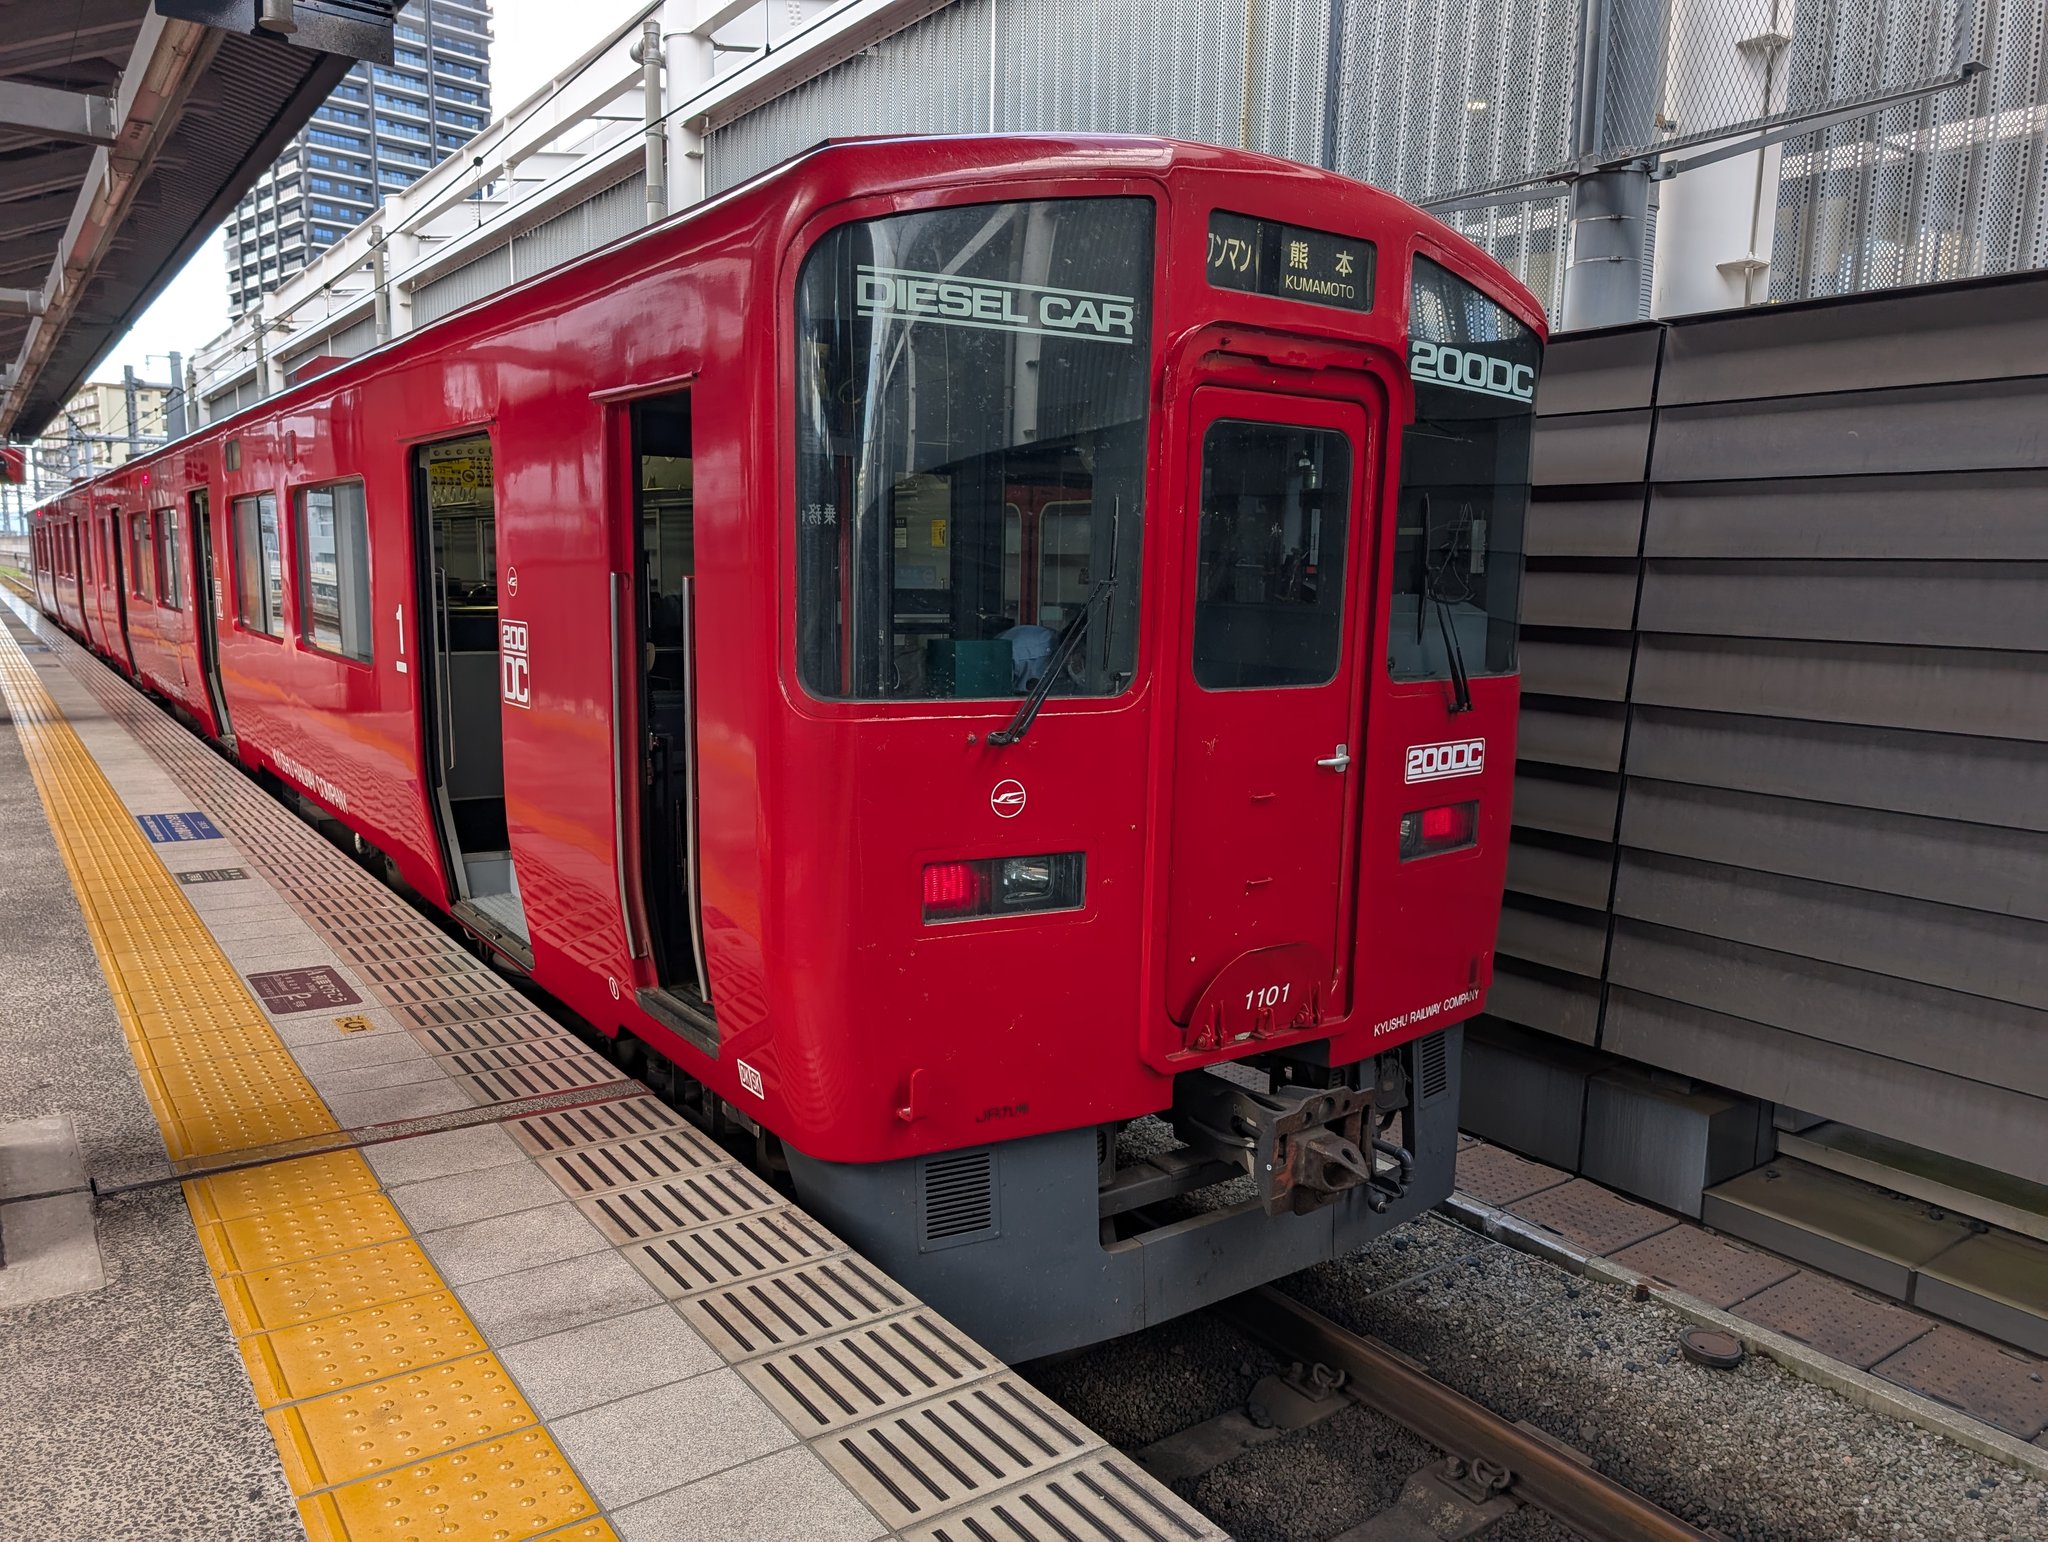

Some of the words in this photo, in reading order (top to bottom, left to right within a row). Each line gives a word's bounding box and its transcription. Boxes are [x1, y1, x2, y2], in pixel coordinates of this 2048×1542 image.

[1289, 240, 1354, 278] 熊本
[856, 274, 1029, 324] DIESEL
[1039, 295, 1134, 335] CAR
[1285, 274, 1355, 299] KUMAMOTO
[1410, 340, 1534, 398] 200DC
[395, 603, 405, 655] 1
[502, 624, 527, 651] 200
[503, 655, 528, 703] DC
[1407, 742, 1483, 775] 200DC
[315, 775, 348, 815] COMPANY
[1245, 983, 1290, 1010] 1101
[1373, 1013, 1408, 1037] KYUSHU
[1409, 1001, 1441, 1023] RAILWAY
[1443, 989, 1480, 1011] COMPANY
